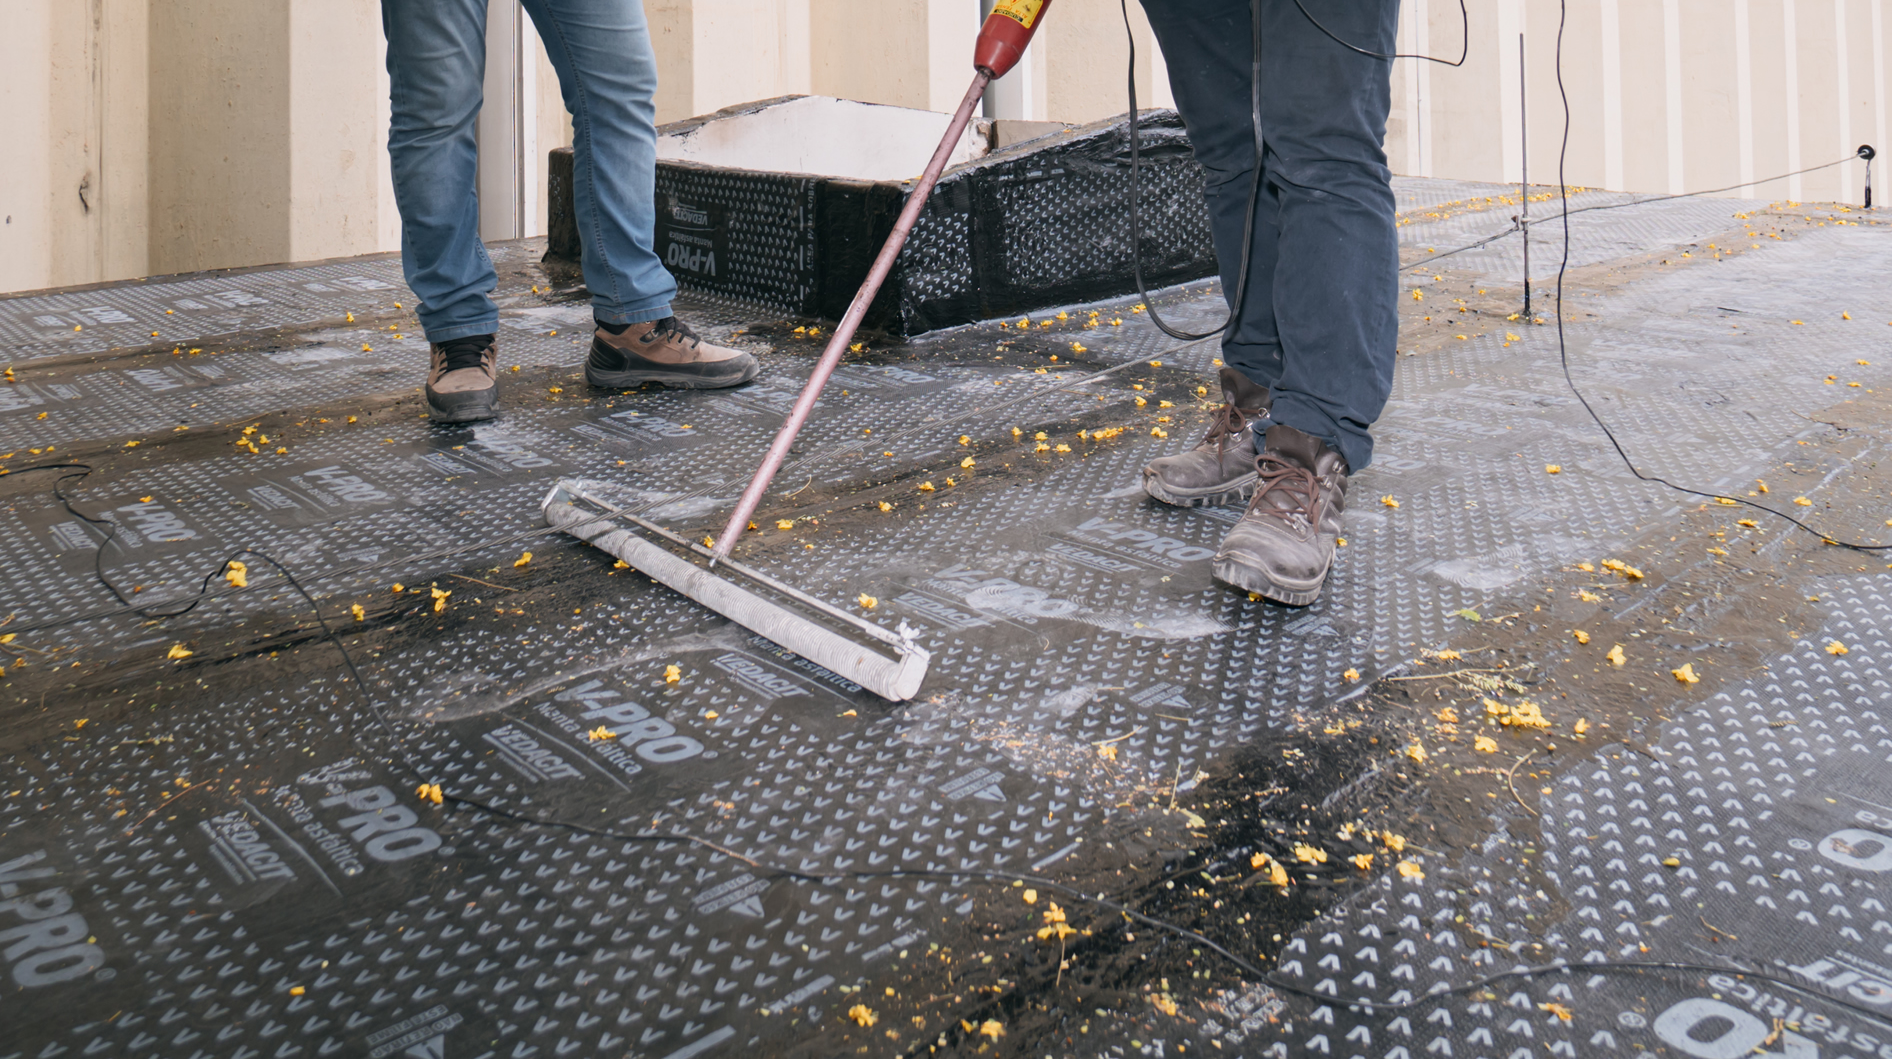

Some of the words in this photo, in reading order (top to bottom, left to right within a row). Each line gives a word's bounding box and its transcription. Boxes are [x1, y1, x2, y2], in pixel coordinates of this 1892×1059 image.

[667, 242, 716, 277] V-PRO
[303, 465, 388, 502] V-PRO
[116, 500, 197, 542] V-PRO
[1076, 516, 1217, 562] V-PRO
[1050, 542, 1142, 572] VEDACIT
[716, 653, 810, 698] VEDACIT
[533, 700, 582, 734] Manta
[553, 678, 705, 763] V-PRO
[490, 723, 584, 779] VEDACIT
[303, 819, 364, 877] asfáltica
[410, 1004, 448, 1025] ESTE
[432, 1012, 464, 1032] NÃO
[366, 1020, 413, 1046] FILME
[370, 1025, 434, 1059] RETIRAR
